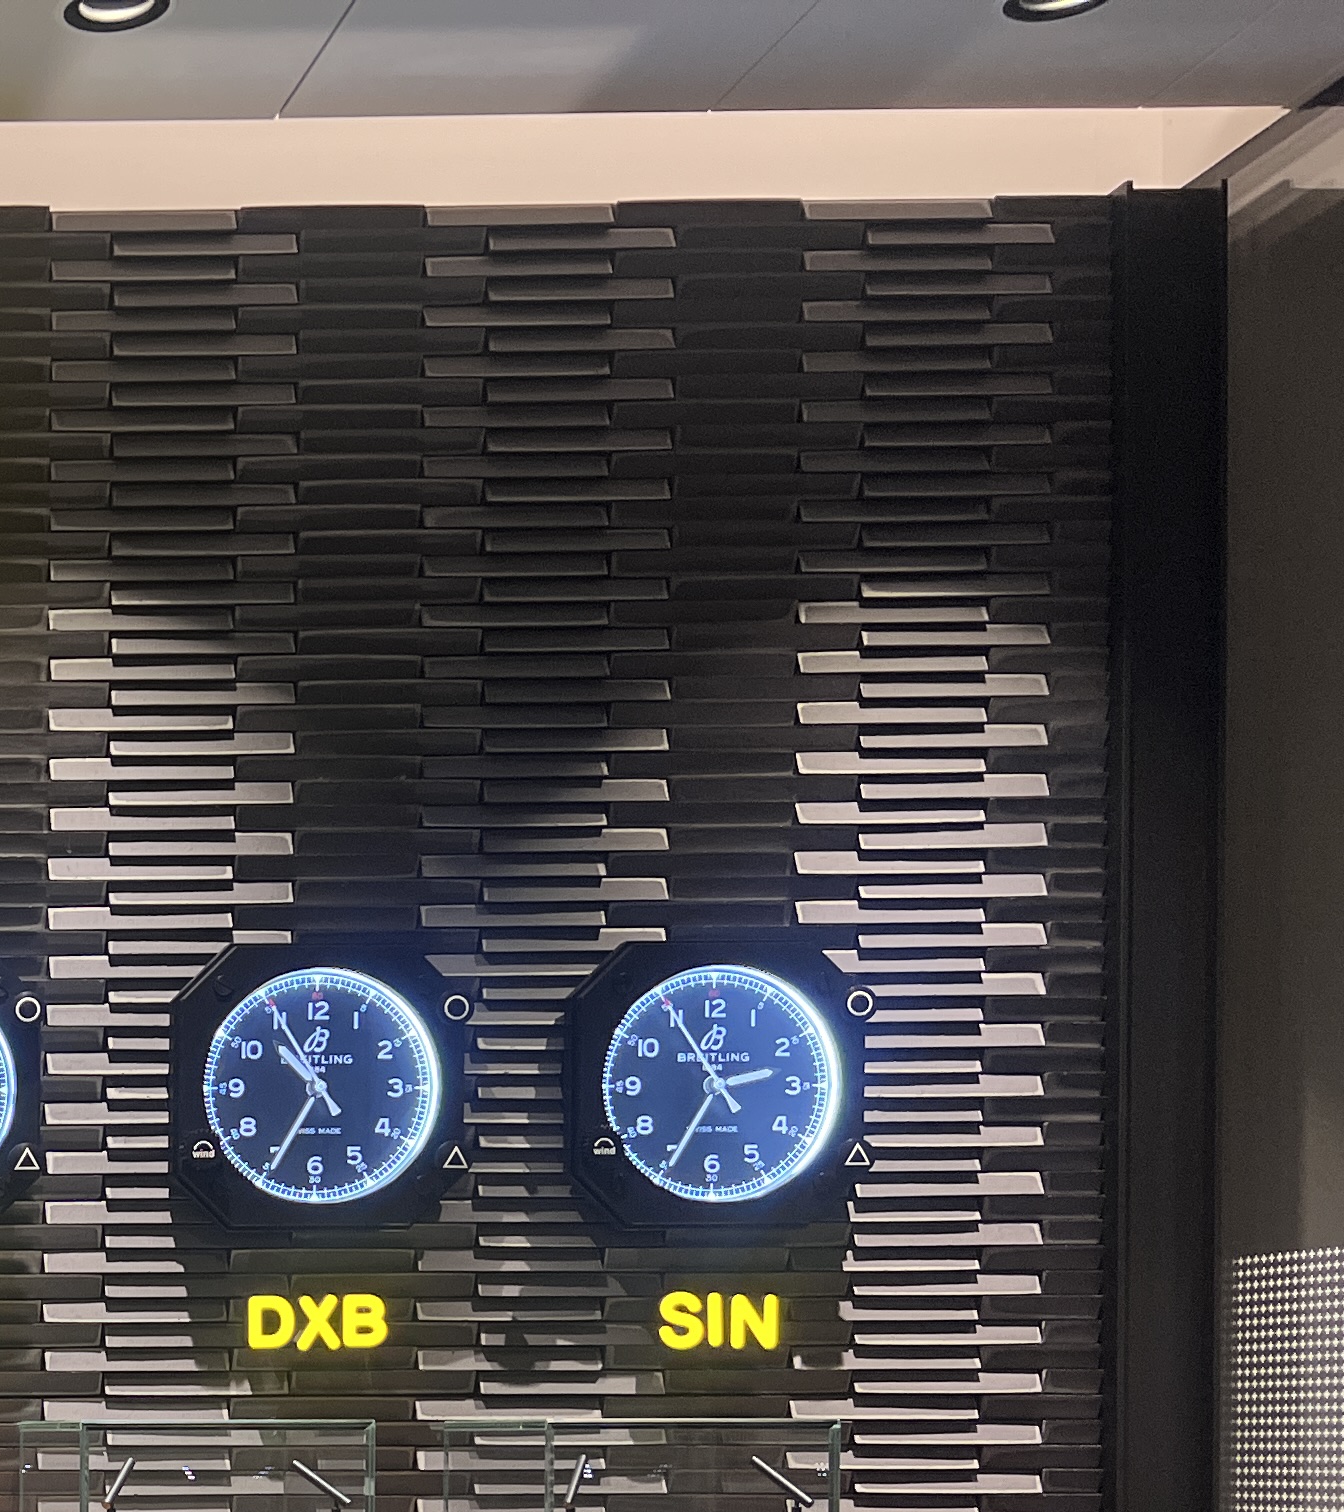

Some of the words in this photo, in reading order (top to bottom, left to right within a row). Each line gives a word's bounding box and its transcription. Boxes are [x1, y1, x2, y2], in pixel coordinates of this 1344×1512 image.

[308, 1002, 329, 1020] 12
[704, 999, 726, 1018] 12
[750, 1009, 756, 1026] 1
[353, 1012, 359, 1029] 1
[241, 1040, 262, 1060] 10
[378, 1040, 394, 1060] 2
[638, 1038, 659, 1057] 10
[774, 1038, 790, 1056] 2
[228, 1078, 244, 1098] 9
[387, 1078, 404, 1098] 3
[625, 1076, 642, 1096] 9
[785, 1076, 802, 1095] 3
[240, 1118, 256, 1136] 8
[374, 1118, 390, 1137] 4
[636, 1116, 654, 1135] 8
[772, 1116, 788, 1134] 4
[192, 1148, 215, 1158] wind
[346, 1146, 362, 1164] 5
[593, 1146, 616, 1155] wind
[744, 1144, 760, 1163] 5
[306, 1156, 323, 1175] 6
[704, 1155, 720, 1173] 6
[248, 1294, 386, 1351] DXB
[660, 1293, 779, 1349] SIN
